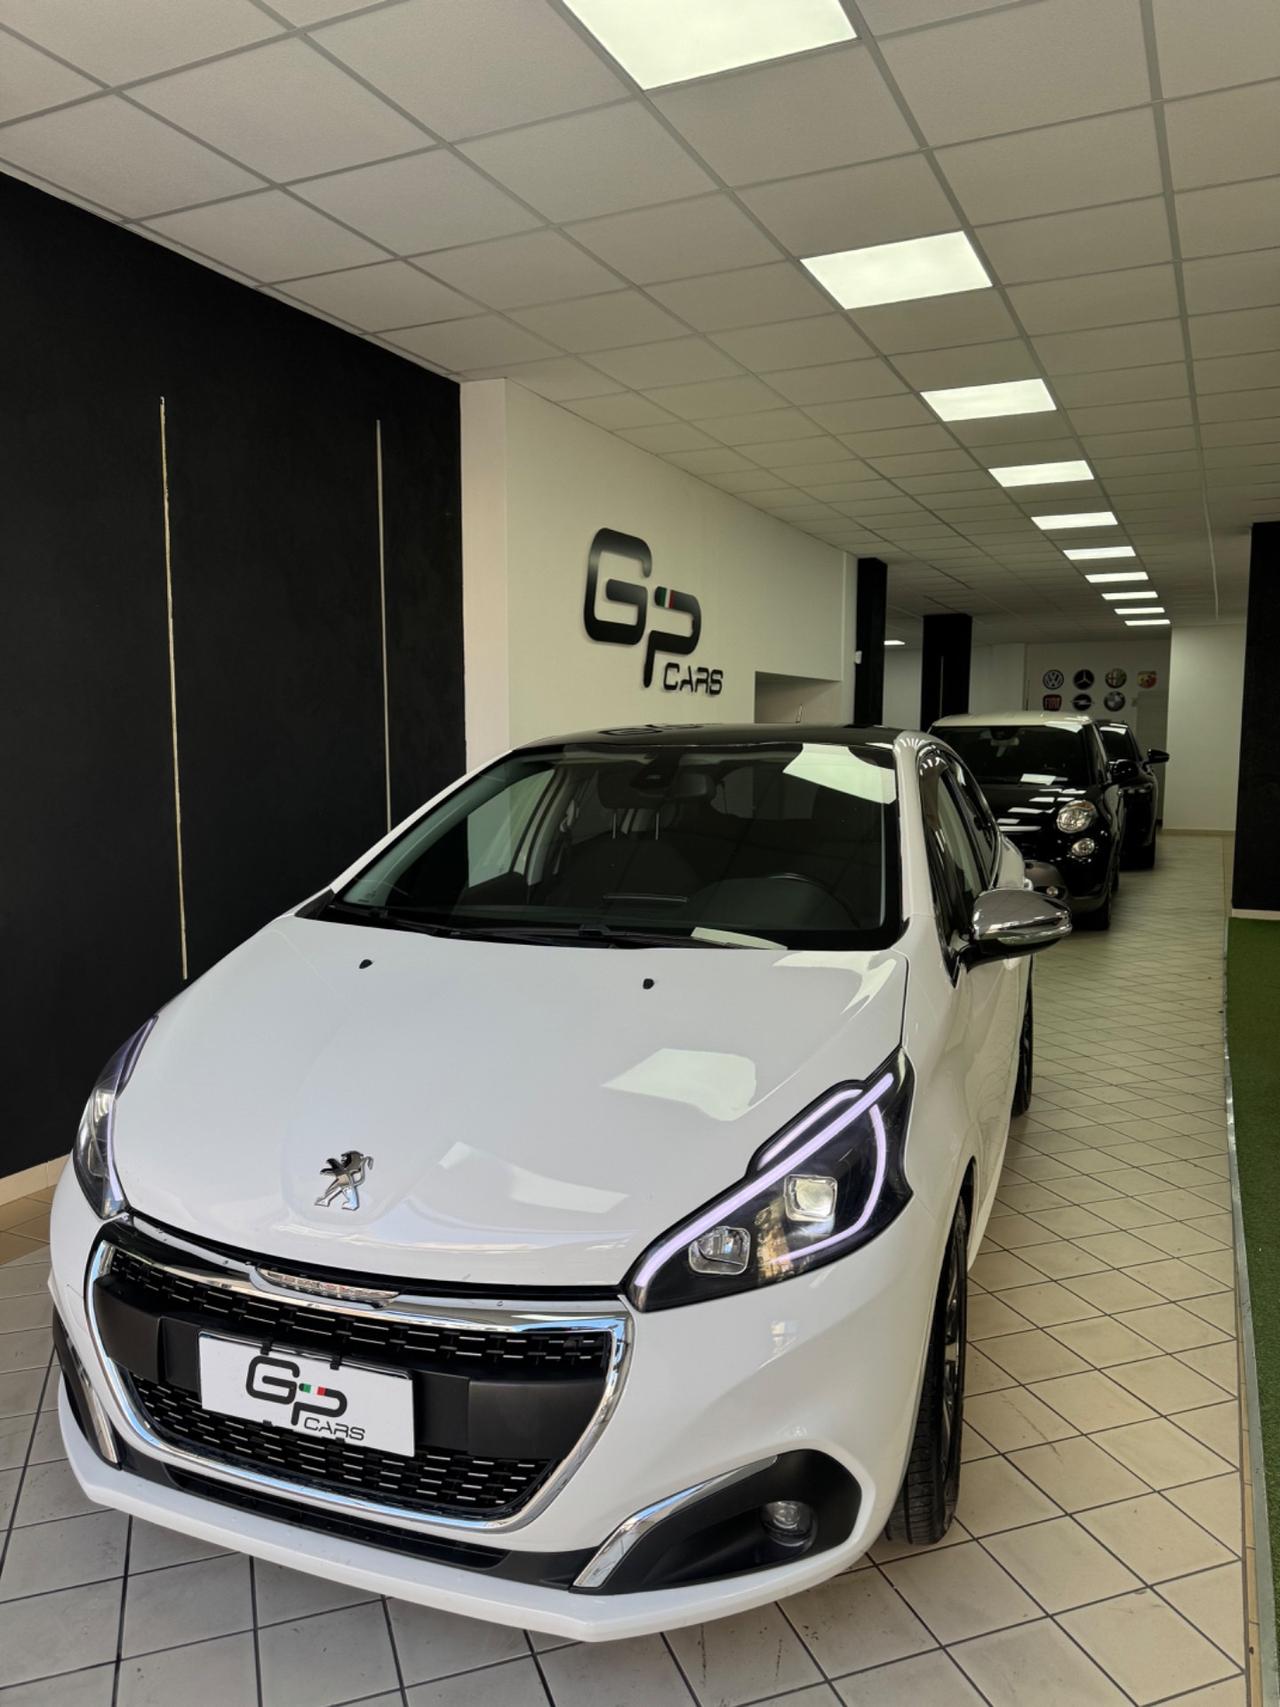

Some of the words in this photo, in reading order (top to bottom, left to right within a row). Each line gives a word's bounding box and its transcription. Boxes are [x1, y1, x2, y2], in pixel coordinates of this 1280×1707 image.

[584, 527, 702, 688] GP
[663, 662, 724, 695] CARS
[245, 1355, 348, 1426] GP
[304, 1416, 366, 1442] CARS
